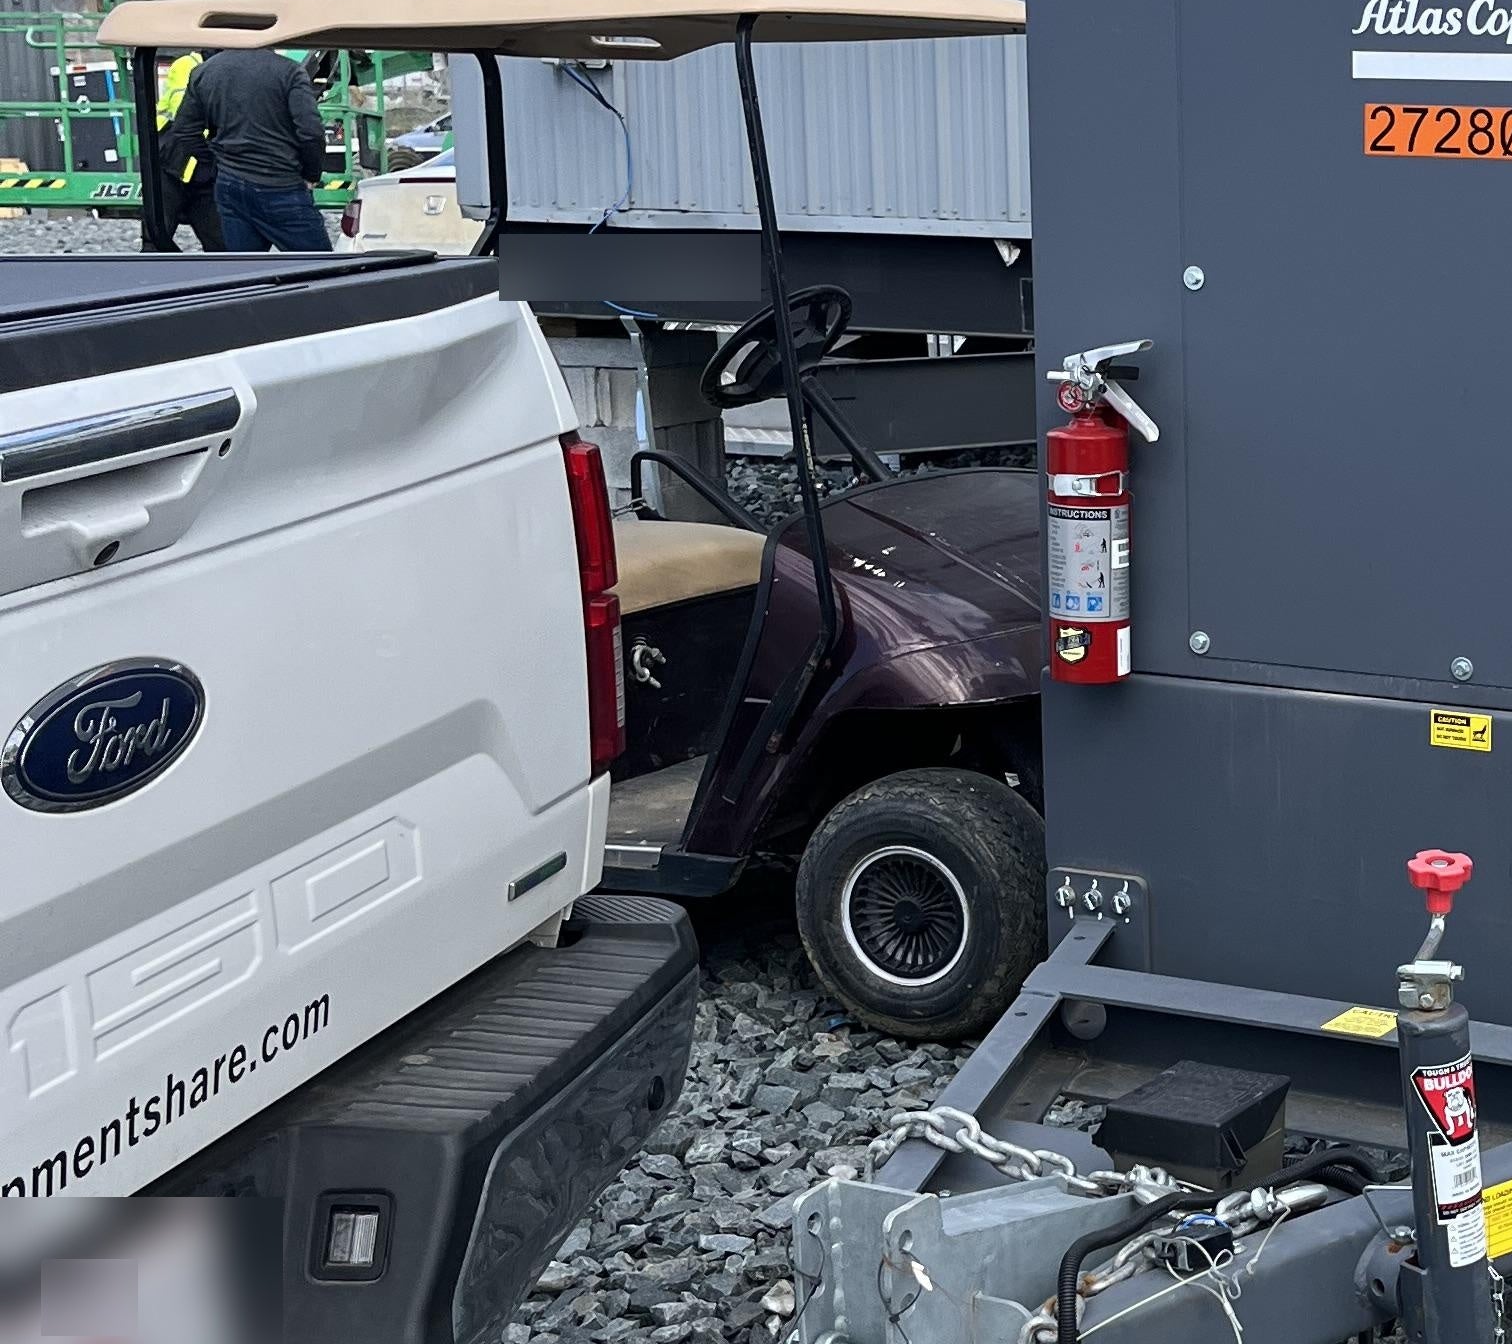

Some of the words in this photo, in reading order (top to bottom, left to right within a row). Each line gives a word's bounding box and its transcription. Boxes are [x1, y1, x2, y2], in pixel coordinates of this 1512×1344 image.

[90, 182, 134, 199] JLG
[66, 690, 173, 785] Ford
[1422, 1067, 1450, 1077] TOUGH
